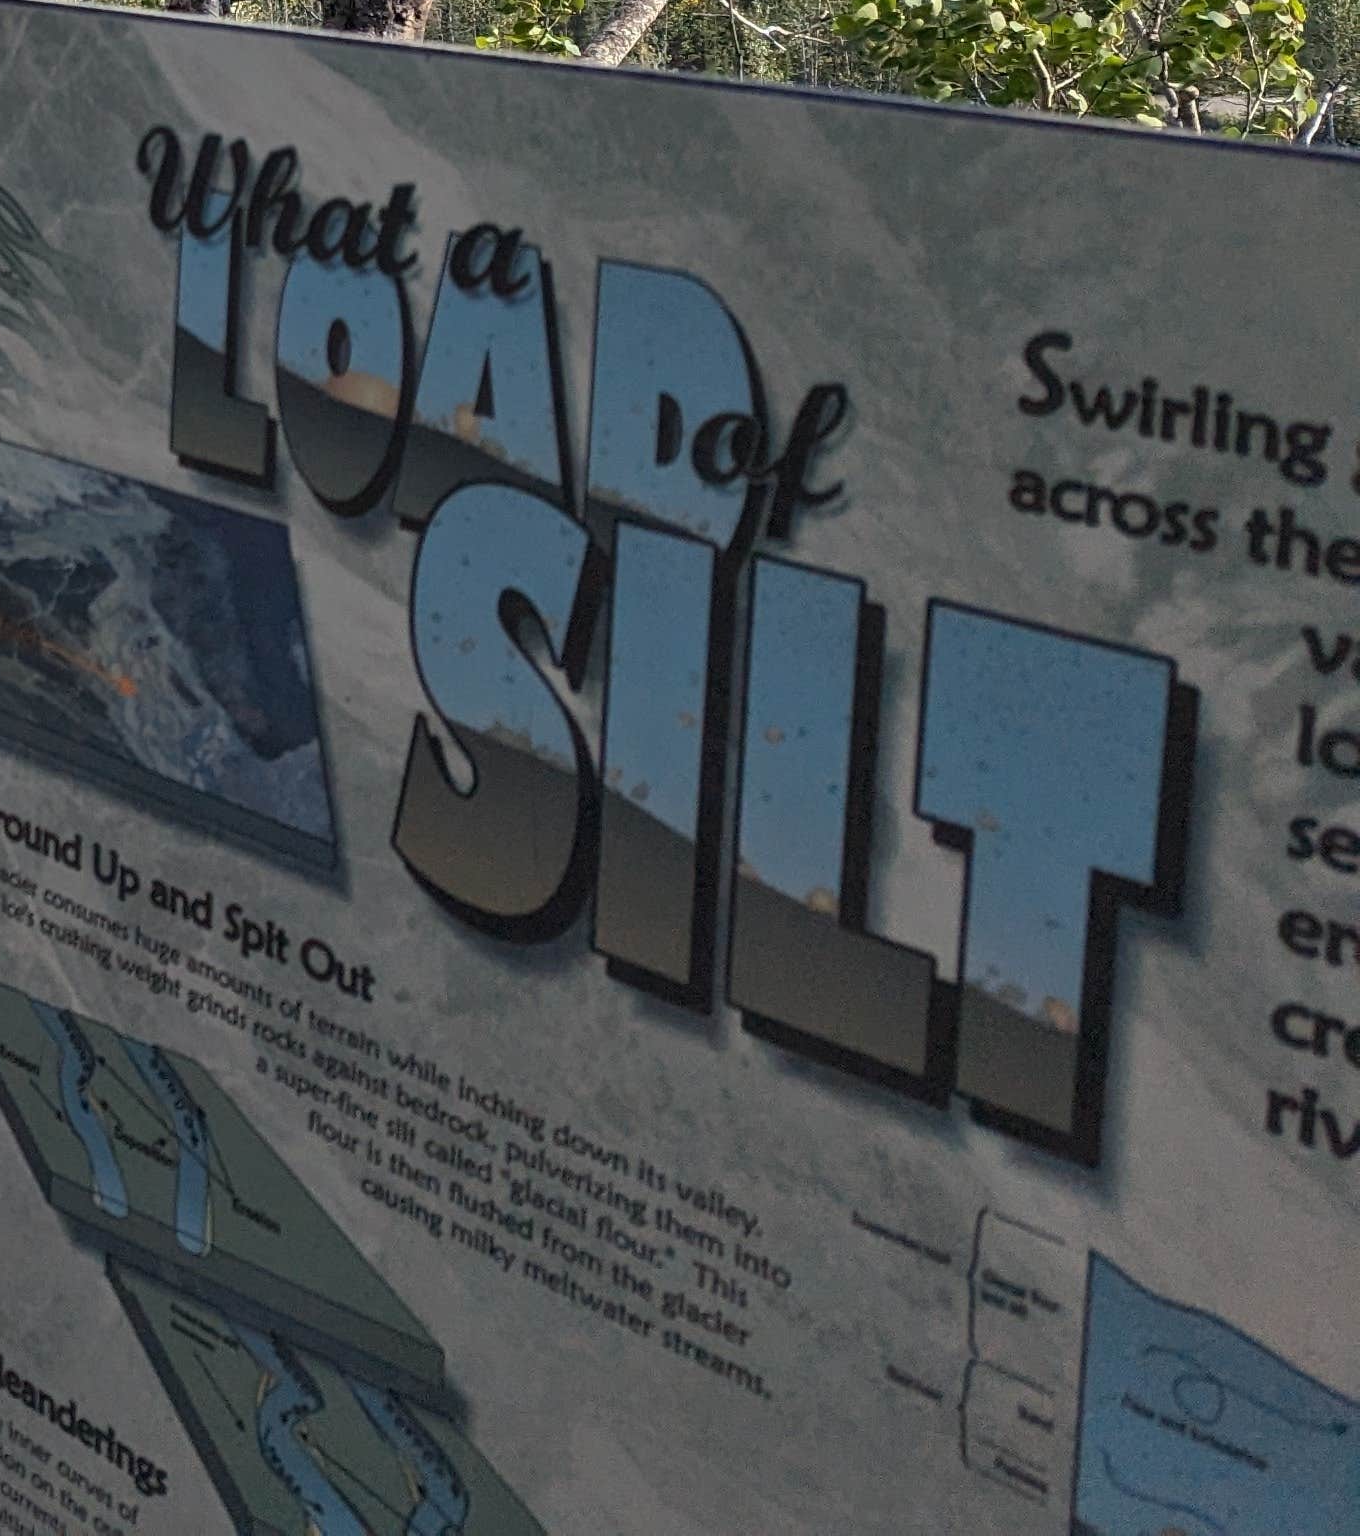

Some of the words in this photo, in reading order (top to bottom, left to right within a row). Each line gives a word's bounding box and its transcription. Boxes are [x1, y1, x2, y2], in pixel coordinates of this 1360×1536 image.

[137, 124, 418, 276] What
[450, 222, 534, 297] a
[169, 191, 770, 559] LOAD
[692, 384, 848, 544] of
[1017, 330, 1333, 487] Swirling
[1008, 470, 1218, 552] across
[92, 842, 140, 901] Up
[150, 878, 213, 931] and
[224, 902, 291, 964] Spit
[300, 938, 377, 1003] Out
[391, 480, 1200, 1168] SILT
[39, 917, 113, 971] crushing
[116, 952, 181, 999] weight
[186, 989, 247, 1031] grinds
[252, 1019, 307, 1060] rocks
[312, 1048, 389, 1099] against
[505, 1140, 647, 1227] pulverizing
[654, 1208, 725, 1258] them
[734, 1243, 792, 1291] into
[43, 888, 129, 941] consumes
[135, 925, 180, 964] huge
[186, 955, 272, 1009] amounts
[279, 999, 304, 1022] of
[309, 1010, 381, 1061] terrain
[387, 1048, 451, 1092] while
[458, 1076, 545, 1142] inching
[552, 1124, 630, 1177] down
[637, 1158, 667, 1193] its
[675, 1182, 763, 1237] valley.
[256, 1056, 269, 1074] a
[274, 1063, 379, 1129] super-fine
[386, 1117, 417, 1148] silt
[423, 1139, 493, 1184] called
[693, 1261, 749, 1309] This
[308, 1109, 359, 1154] flour
[367, 1139, 382, 1166] is
[388, 1152, 442, 1196] then
[448, 1180, 534, 1241] flushed
[542, 1226, 604, 1276] from
[610, 1263, 655, 1302] the
[660, 1291, 752, 1346] glacier
[360, 1178, 444, 1240] causing
[450, 1222, 517, 1272] milky
[522, 1258, 657, 1338] meltwater
[660, 1329, 772, 1401] streams.
[31, 1472, 56, 1500] on
[57, 1459, 114, 1509] curves
[117, 1501, 140, 1526] of
